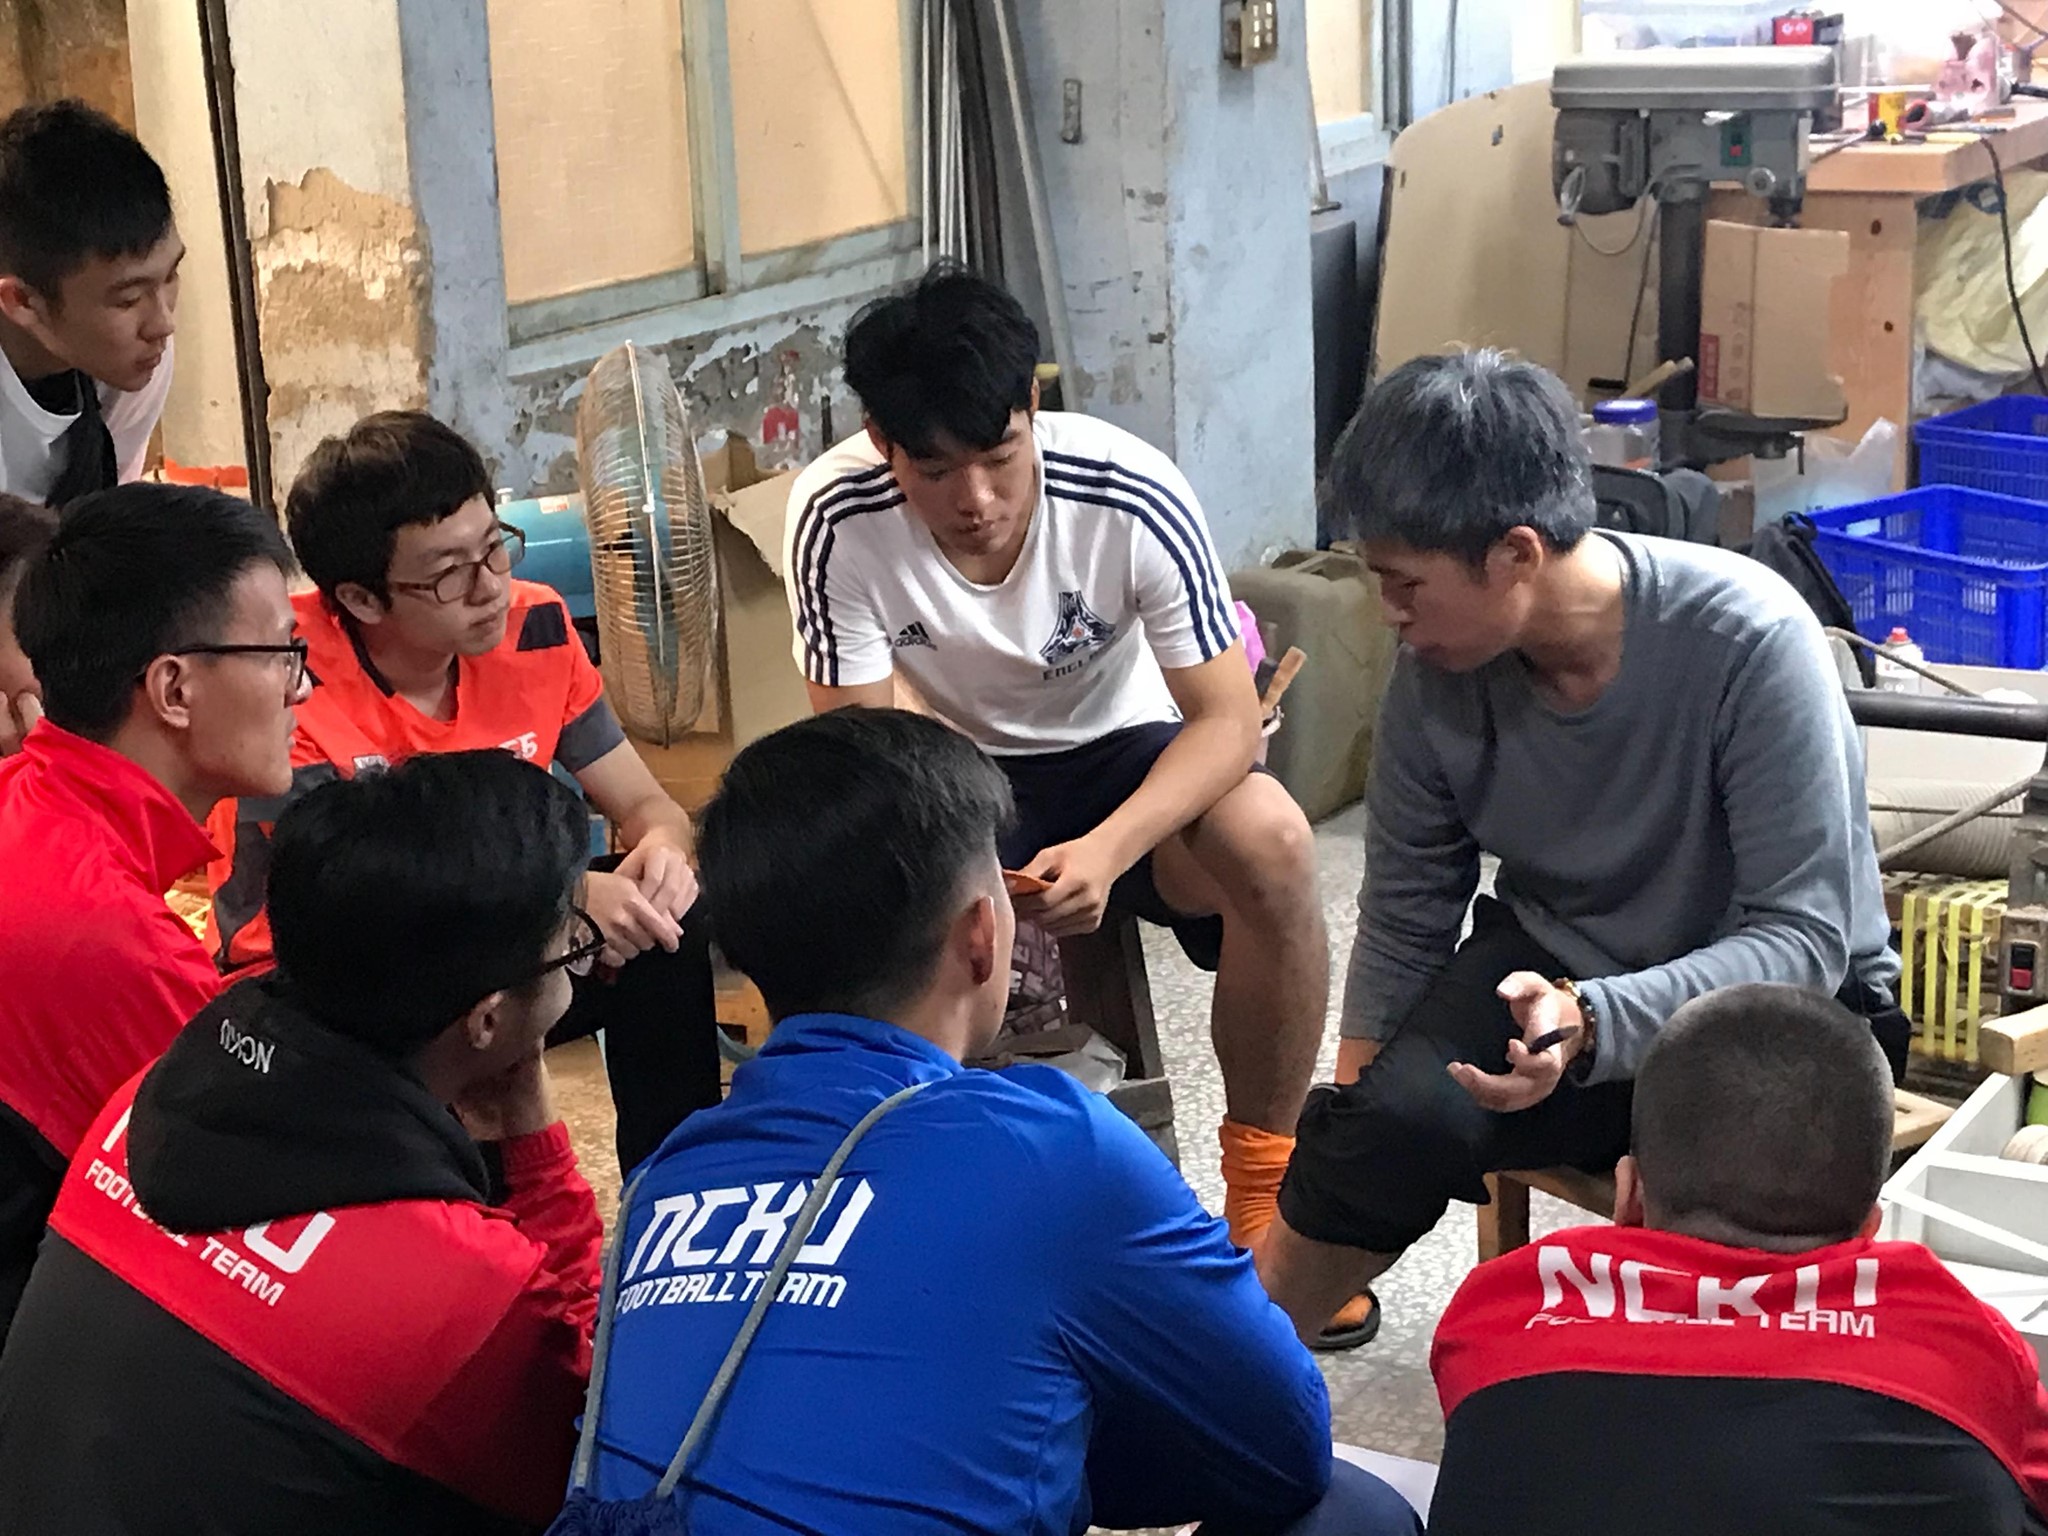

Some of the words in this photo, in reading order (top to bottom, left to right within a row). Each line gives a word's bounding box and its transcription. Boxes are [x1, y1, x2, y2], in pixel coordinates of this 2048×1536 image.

[219, 1018, 275, 1074] NCKU
[84, 1158, 189, 1247] FOOT
[199, 1236, 286, 1307] TEAM
[621, 1178, 875, 1283] NCKU
[615, 1270, 735, 1314] FOOTBALL
